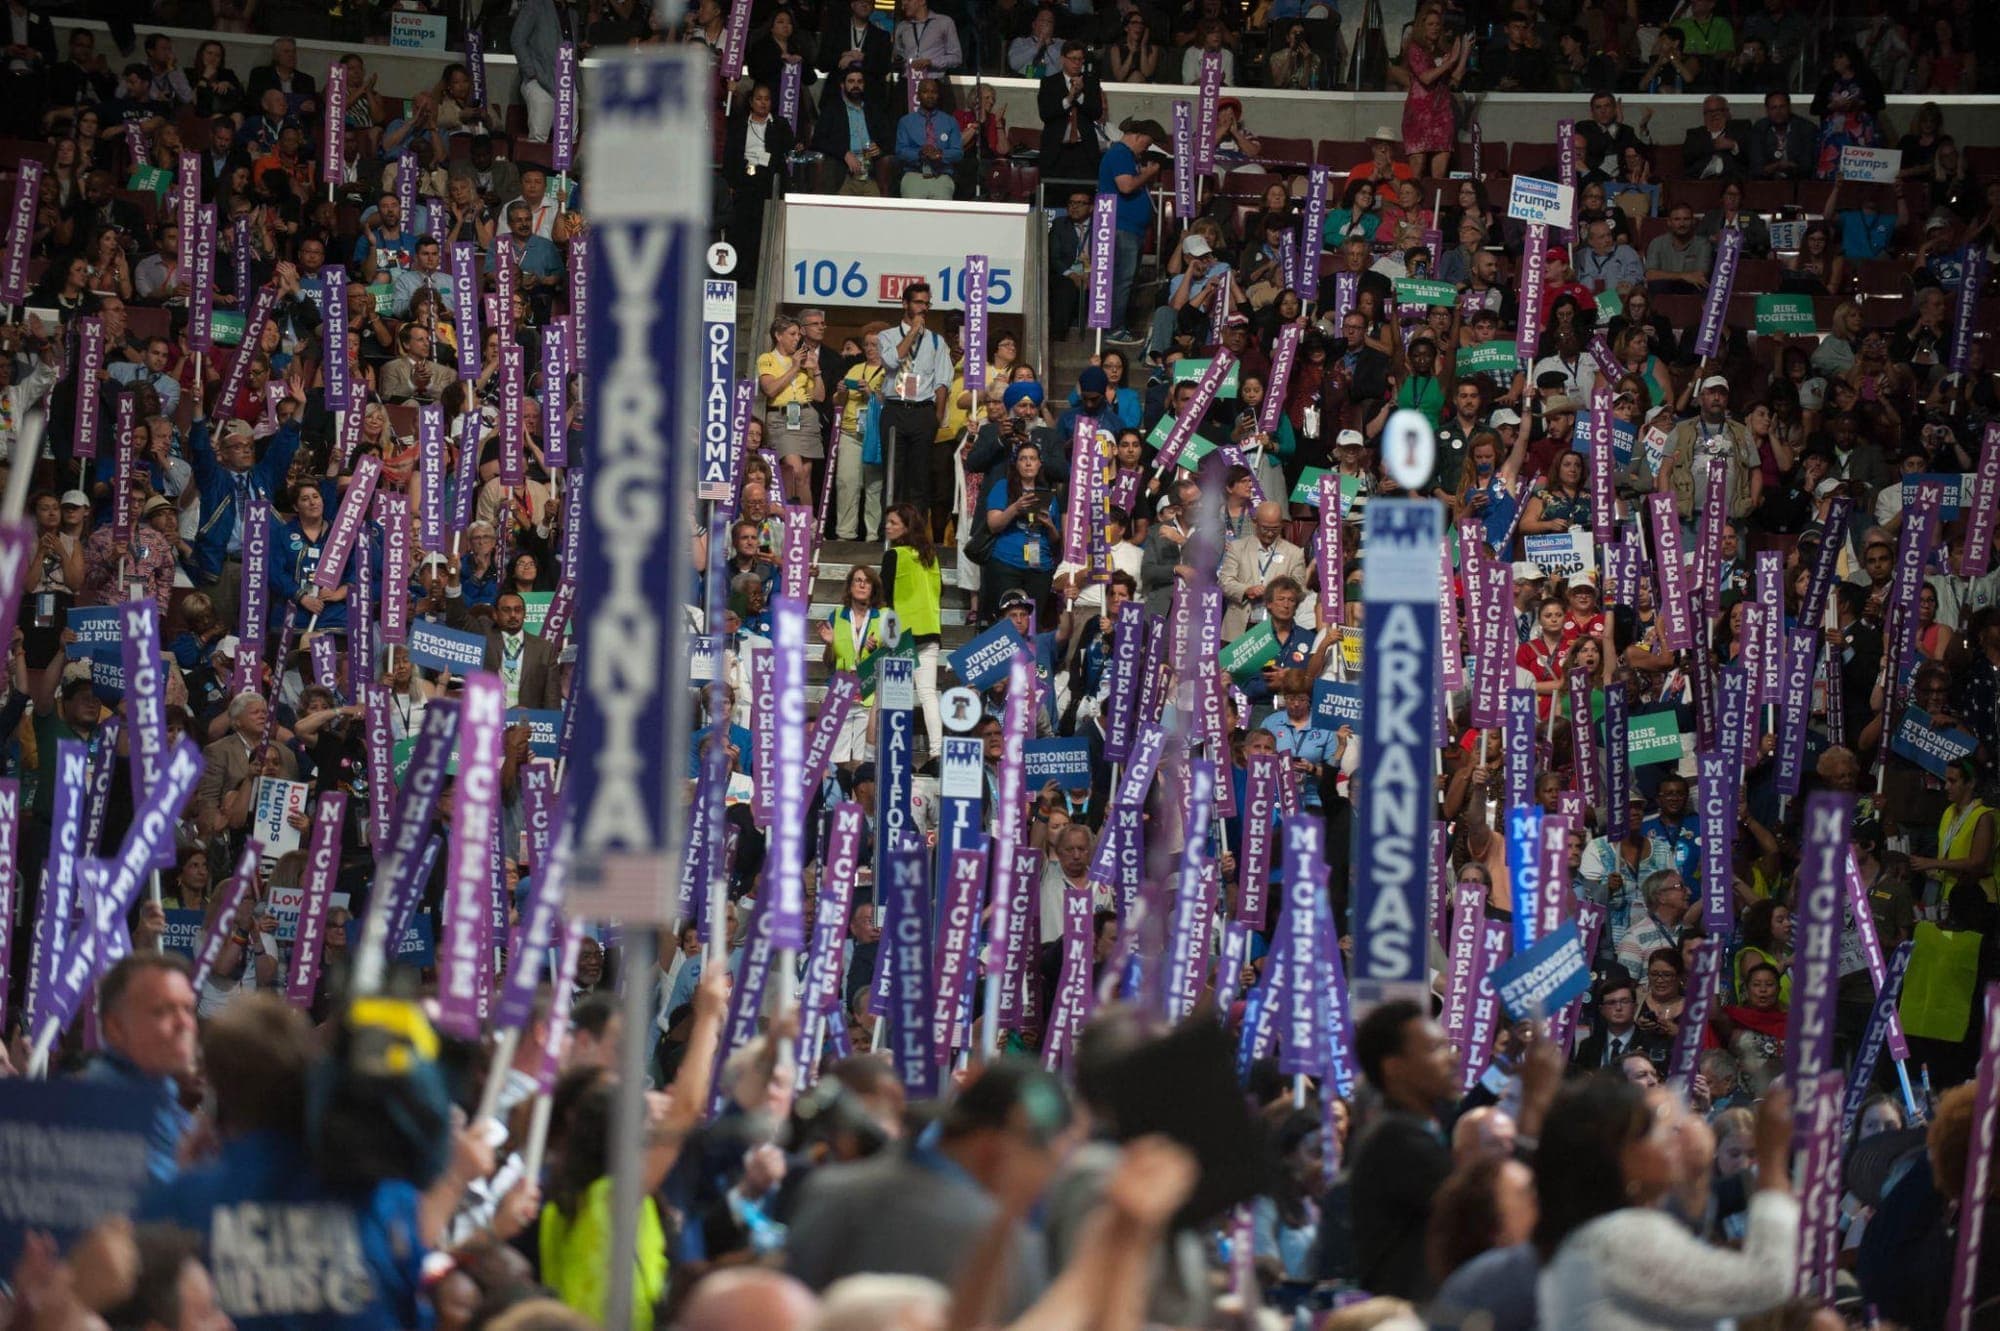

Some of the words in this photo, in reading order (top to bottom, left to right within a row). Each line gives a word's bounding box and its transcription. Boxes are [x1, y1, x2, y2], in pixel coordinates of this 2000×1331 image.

[392, 36, 424, 48] hate.
[393, 15, 422, 25] Love
[393, 26, 435, 39] trumps
[728, 0, 747, 65] HELLE
[127, 123, 147, 165] MICH
[328, 66, 345, 171] MICHELLE
[557, 48, 573, 157] MICHELLE
[783, 66, 797, 122] MICH
[1198, 58, 1218, 165] MICHELLE
[400, 155, 415, 233] MICHEL
[1176, 105, 1190, 206] MICHELLE
[1513, 191, 1561, 211] trumps
[1843, 157, 1888, 170] trumps
[1844, 147, 1875, 158] Love
[6, 164, 36, 290] MICHELLE
[184, 157, 197, 268] MICHELLE
[234, 219, 248, 303] MICHEL
[1095, 201, 1112, 314] MICHELLE
[1283, 233, 1293, 290] MICH
[1301, 170, 1325, 286] MICHELLE
[194, 209, 214, 336] MICHELLE
[455, 247, 475, 366] MICHELLE
[574, 241, 587, 358] MICHELLE
[795, 260, 868, 297] 106
[970, 261, 984, 375] MICHELLE
[1523, 225, 1544, 345] MICHELLE
[1704, 234, 1738, 345] MICHELLE
[1756, 313, 1814, 323] TOGETHER
[1773, 304, 1798, 314] RISE
[1956, 249, 1981, 360] MICHELLE
[80, 323, 101, 443] MICHELLE
[222, 291, 275, 408] MICHELLE
[326, 269, 343, 396] MICHELLE
[1264, 326, 1296, 422] MICHELLE
[1457, 353, 1515, 368] TOGETHER
[1472, 346, 1498, 358] RISE
[505, 353, 519, 472] MICHELLE
[546, 331, 561, 453] MICHELLE
[704, 324, 731, 481] OKLAHOMA
[1166, 352, 1233, 454] MICHELLE
[1577, 421, 1633, 443] STGER
[118, 397, 134, 526] MICHELLE
[424, 410, 439, 535] MICHELLE
[455, 413, 479, 522] MICHELLE
[1071, 422, 1093, 548] MICHELLE
[1596, 396, 1612, 526] MICHELLE
[246, 506, 270, 639] MICHELLE
[322, 460, 380, 575] MICHELLE
[386, 501, 405, 629] MICHELLE
[566, 474, 584, 579] MICHELL
[582, 226, 673, 850] VIRGINIA
[788, 513, 807, 598] MICHE
[1323, 480, 1340, 608] MICHELLE
[1528, 552, 1570, 565] trumps
[1654, 498, 1685, 633] MICHELLE
[1705, 467, 1723, 600] MICHELLE
[1801, 503, 1848, 629] MICHELLE
[80, 620, 122, 633] JUNTO
[412, 640, 481, 666] TOGETHER
[413, 630, 482, 654] STRONGER
[546, 586, 574, 642] MICH
[964, 635, 1010, 670] JUNTOS
[965, 665, 985, 682] SE
[981, 642, 1021, 675] PUEDE
[1201, 592, 1217, 655] MICH
[1226, 633, 1273, 674] OGETHER
[1231, 636, 1255, 659] RISE
[1476, 569, 1506, 713] MICHELLE
[1690, 596, 1711, 732] MICHELLE
[1763, 557, 1779, 688] MICHELLE
[93, 662, 125, 678] STRO
[93, 675, 125, 691] TOGE
[127, 608, 160, 785] MICHEL
[1111, 608, 1139, 745] MICHELLE
[1318, 703, 1332, 714] SE
[1323, 692, 1363, 708] JUNTO
[1712, 677, 1738, 757] MICH
[1780, 636, 1811, 777] MICHELLE
[370, 691, 390, 839] MICHELLE
[756, 655, 774, 807] MICHELLE
[800, 678, 854, 786] MICHEL
[887, 711, 905, 850] CALIFOR
[1024, 751, 1088, 764] STRONGER
[1025, 762, 1089, 775] TOGETHER
[1508, 696, 1530, 808] MICHEL
[1611, 688, 1625, 824] MICHELLE
[1626, 734, 1678, 752] GETHER
[1903, 718, 1970, 757] STRONGER
[85, 726, 118, 858] MICHEL
[271, 782, 289, 841] trumps
[291, 785, 305, 815] Lov
[1247, 762, 1271, 912] MICHELLE
[1367, 606, 1425, 978] ARKANSAS
[1704, 760, 1725, 914] MICHELLE
[271, 890, 302, 905] Lov
[295, 801, 341, 986] MICHELLE
[1000, 857, 1035, 1010] MICHELLE
[1512, 817, 1540, 942] MICHE
[1543, 828, 1565, 931] MICH
[894, 861, 925, 1085] MICHELLE
[934, 859, 979, 1044] MICHELLE
[1181, 864, 1214, 1017] MICHELLE
[1291, 826, 1317, 1048] MICHELLE
[1448, 890, 1480, 1029] MICHELLE
[1795, 808, 1843, 1113] MICHELLE
[1464, 929, 1505, 1093] MICHELL
